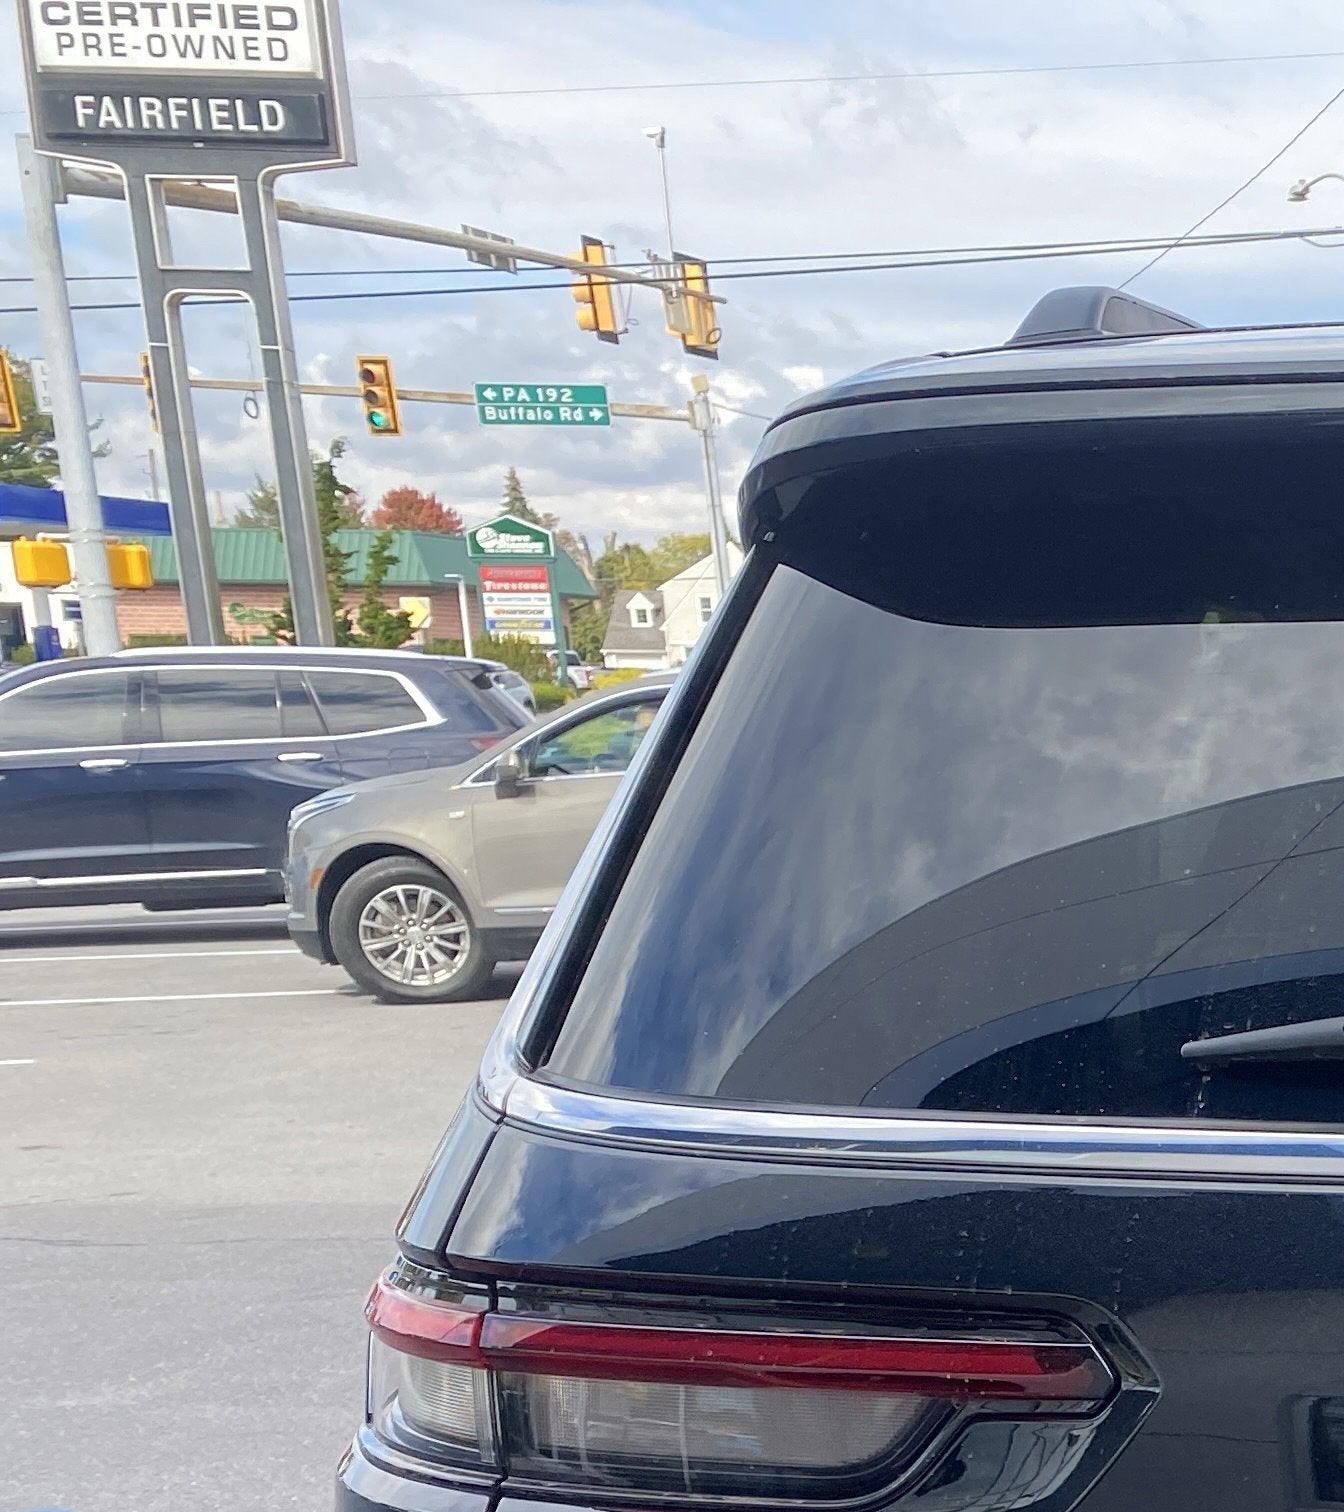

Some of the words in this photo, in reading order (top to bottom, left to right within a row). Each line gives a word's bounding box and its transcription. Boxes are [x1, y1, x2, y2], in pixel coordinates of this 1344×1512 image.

[41, 1, 299, 32] CERTIFIED
[56, 31, 290, 62] PRE-OWNED
[74, 95, 286, 132] FAIRFIELD
[502, 387, 531, 402] PA
[536, 388, 574, 402] 192
[484, 405, 553, 421] Buffalo
[559, 407, 584, 422] Rd
